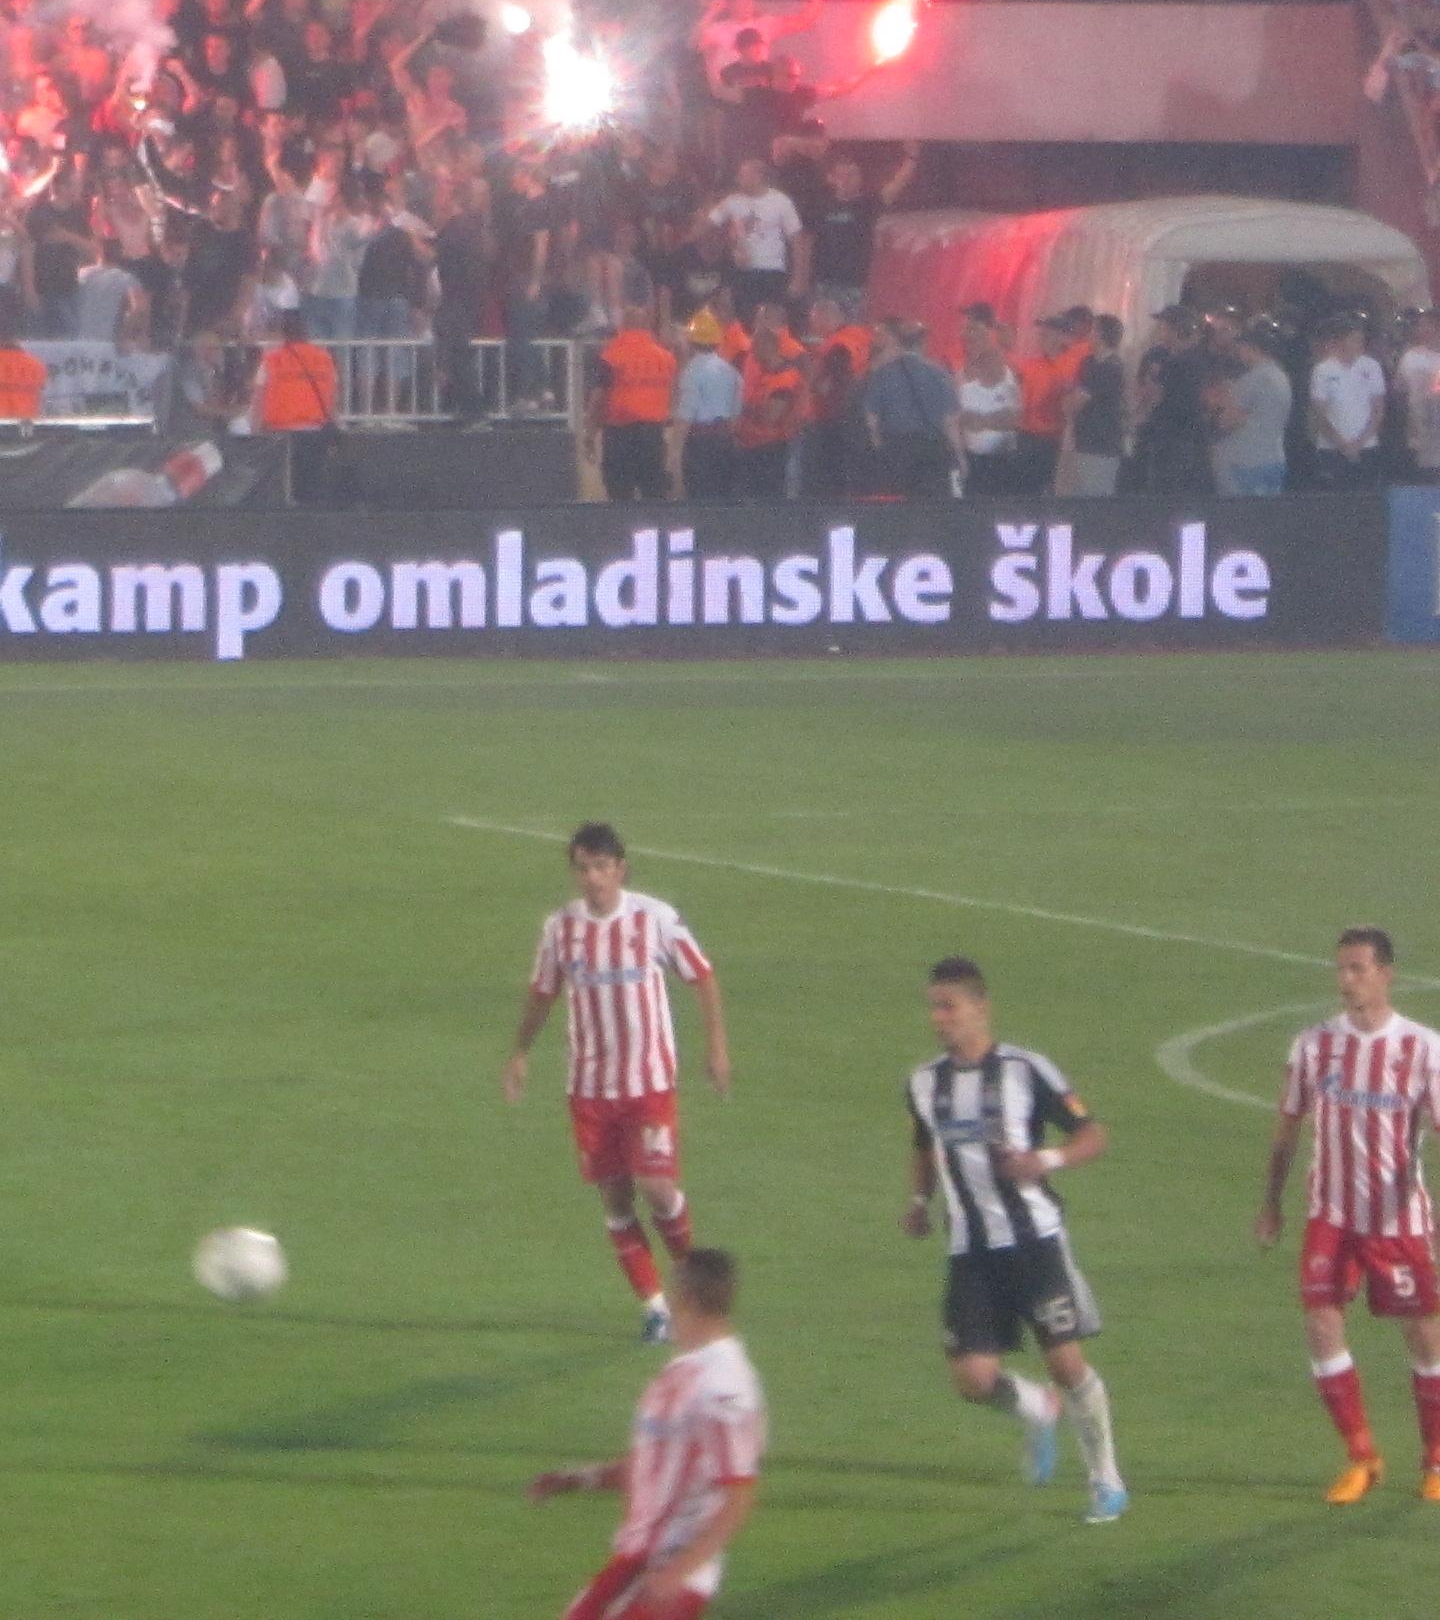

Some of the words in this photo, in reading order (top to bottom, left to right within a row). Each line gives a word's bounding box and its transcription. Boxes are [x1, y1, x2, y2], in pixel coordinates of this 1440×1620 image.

[319, 527, 952, 630] omladinske
[988, 522, 1271, 623] škole
[1391, 1265, 1416, 1298] 5
